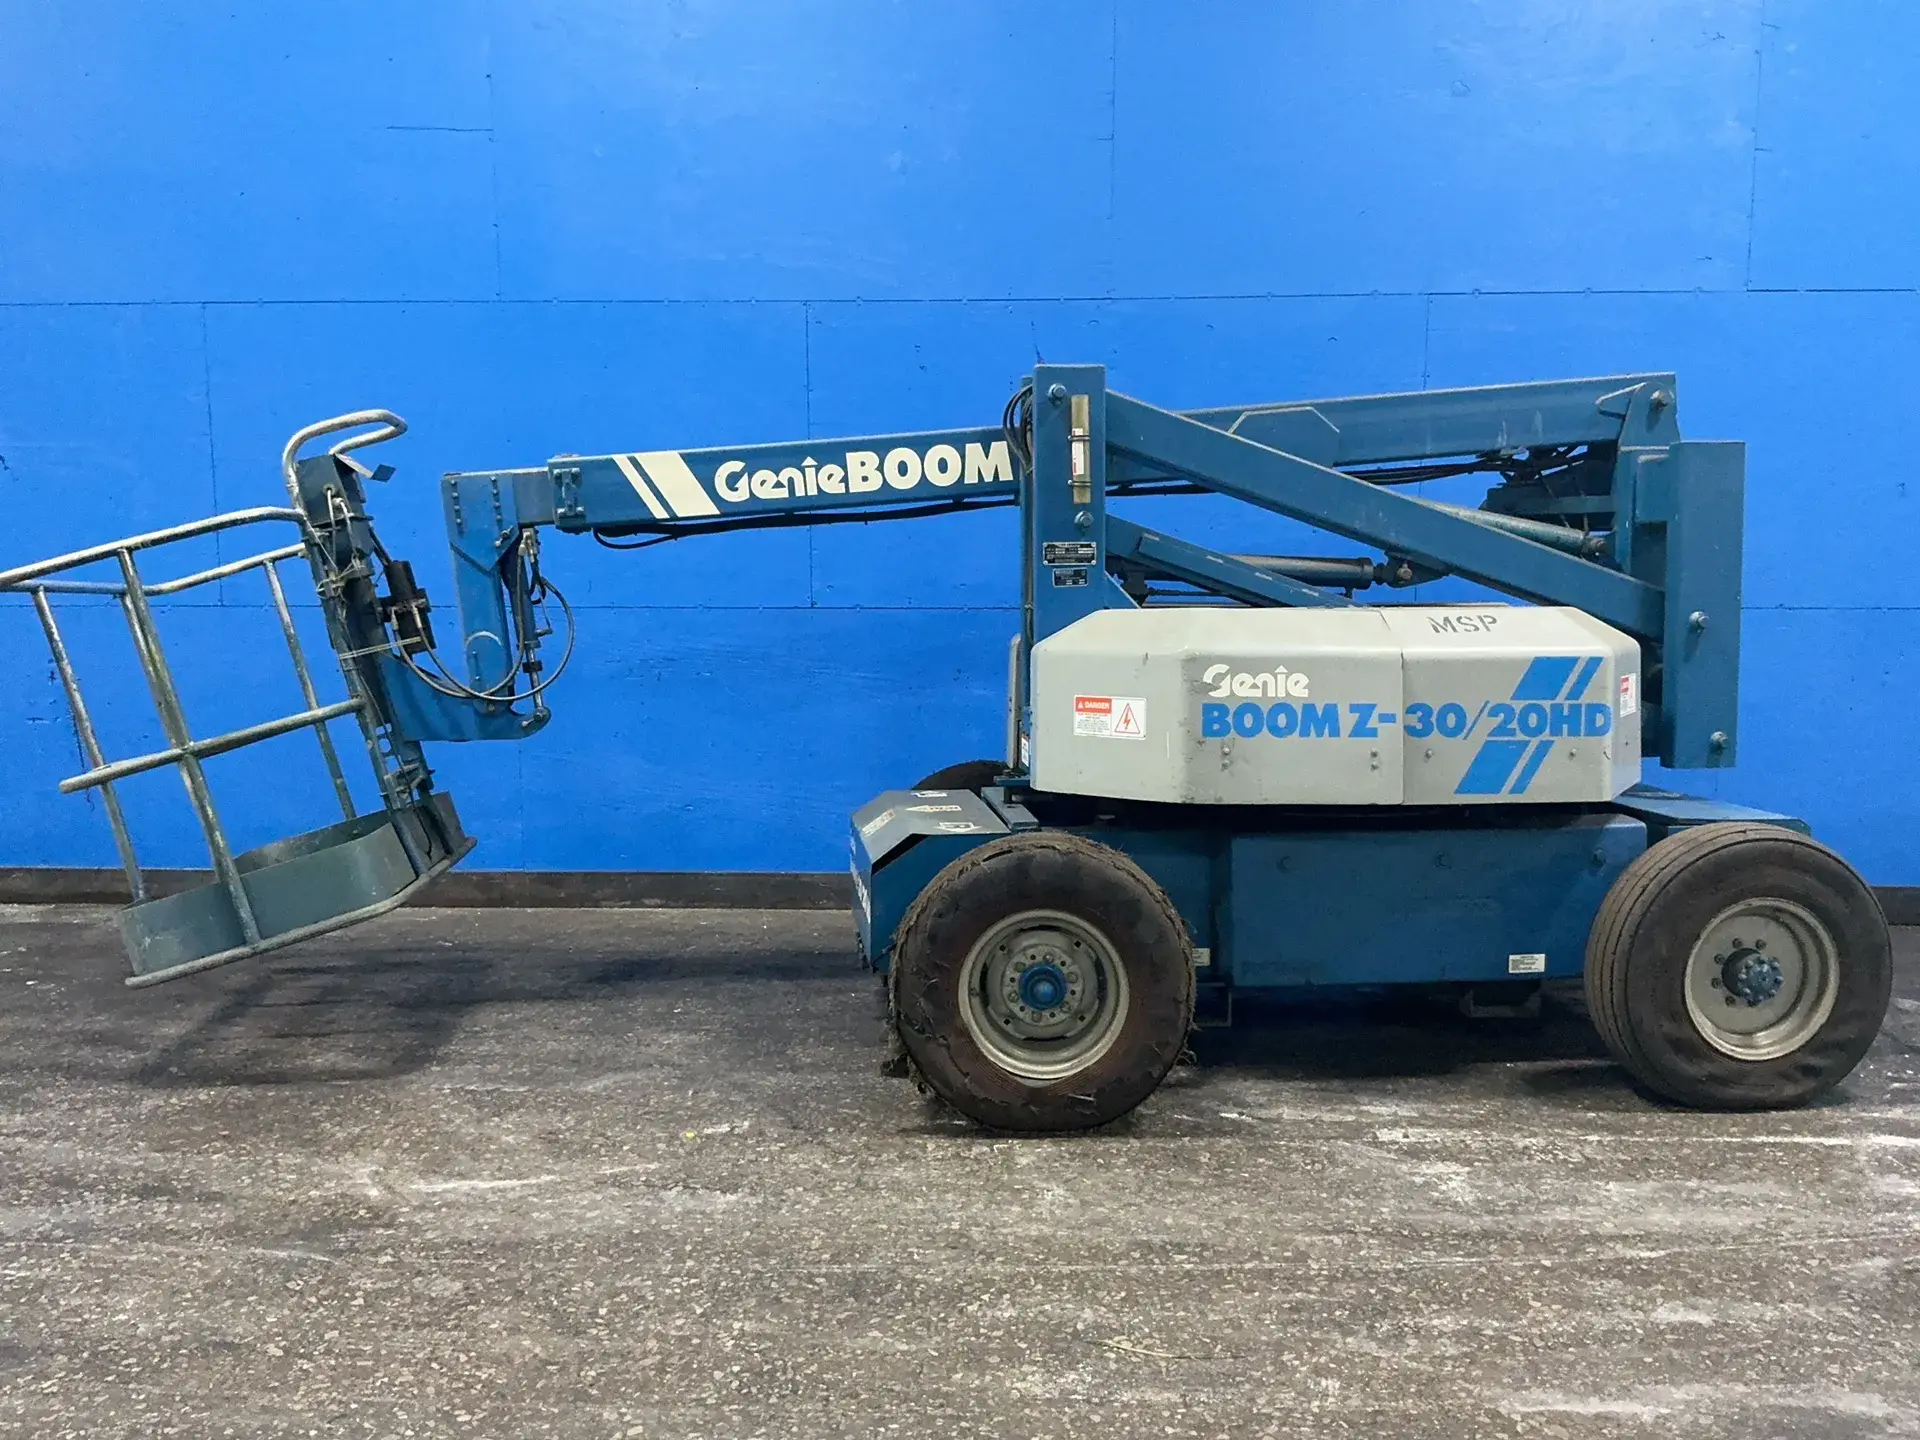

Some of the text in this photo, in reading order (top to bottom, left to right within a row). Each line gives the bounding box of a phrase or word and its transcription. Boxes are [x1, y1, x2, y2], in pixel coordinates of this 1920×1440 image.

[1427, 615, 1497, 634] MSP
[1203, 664, 1309, 698] Genie
[1084, 700, 1110, 710] DANGER
[1202, 702, 1340, 738] BOOM
